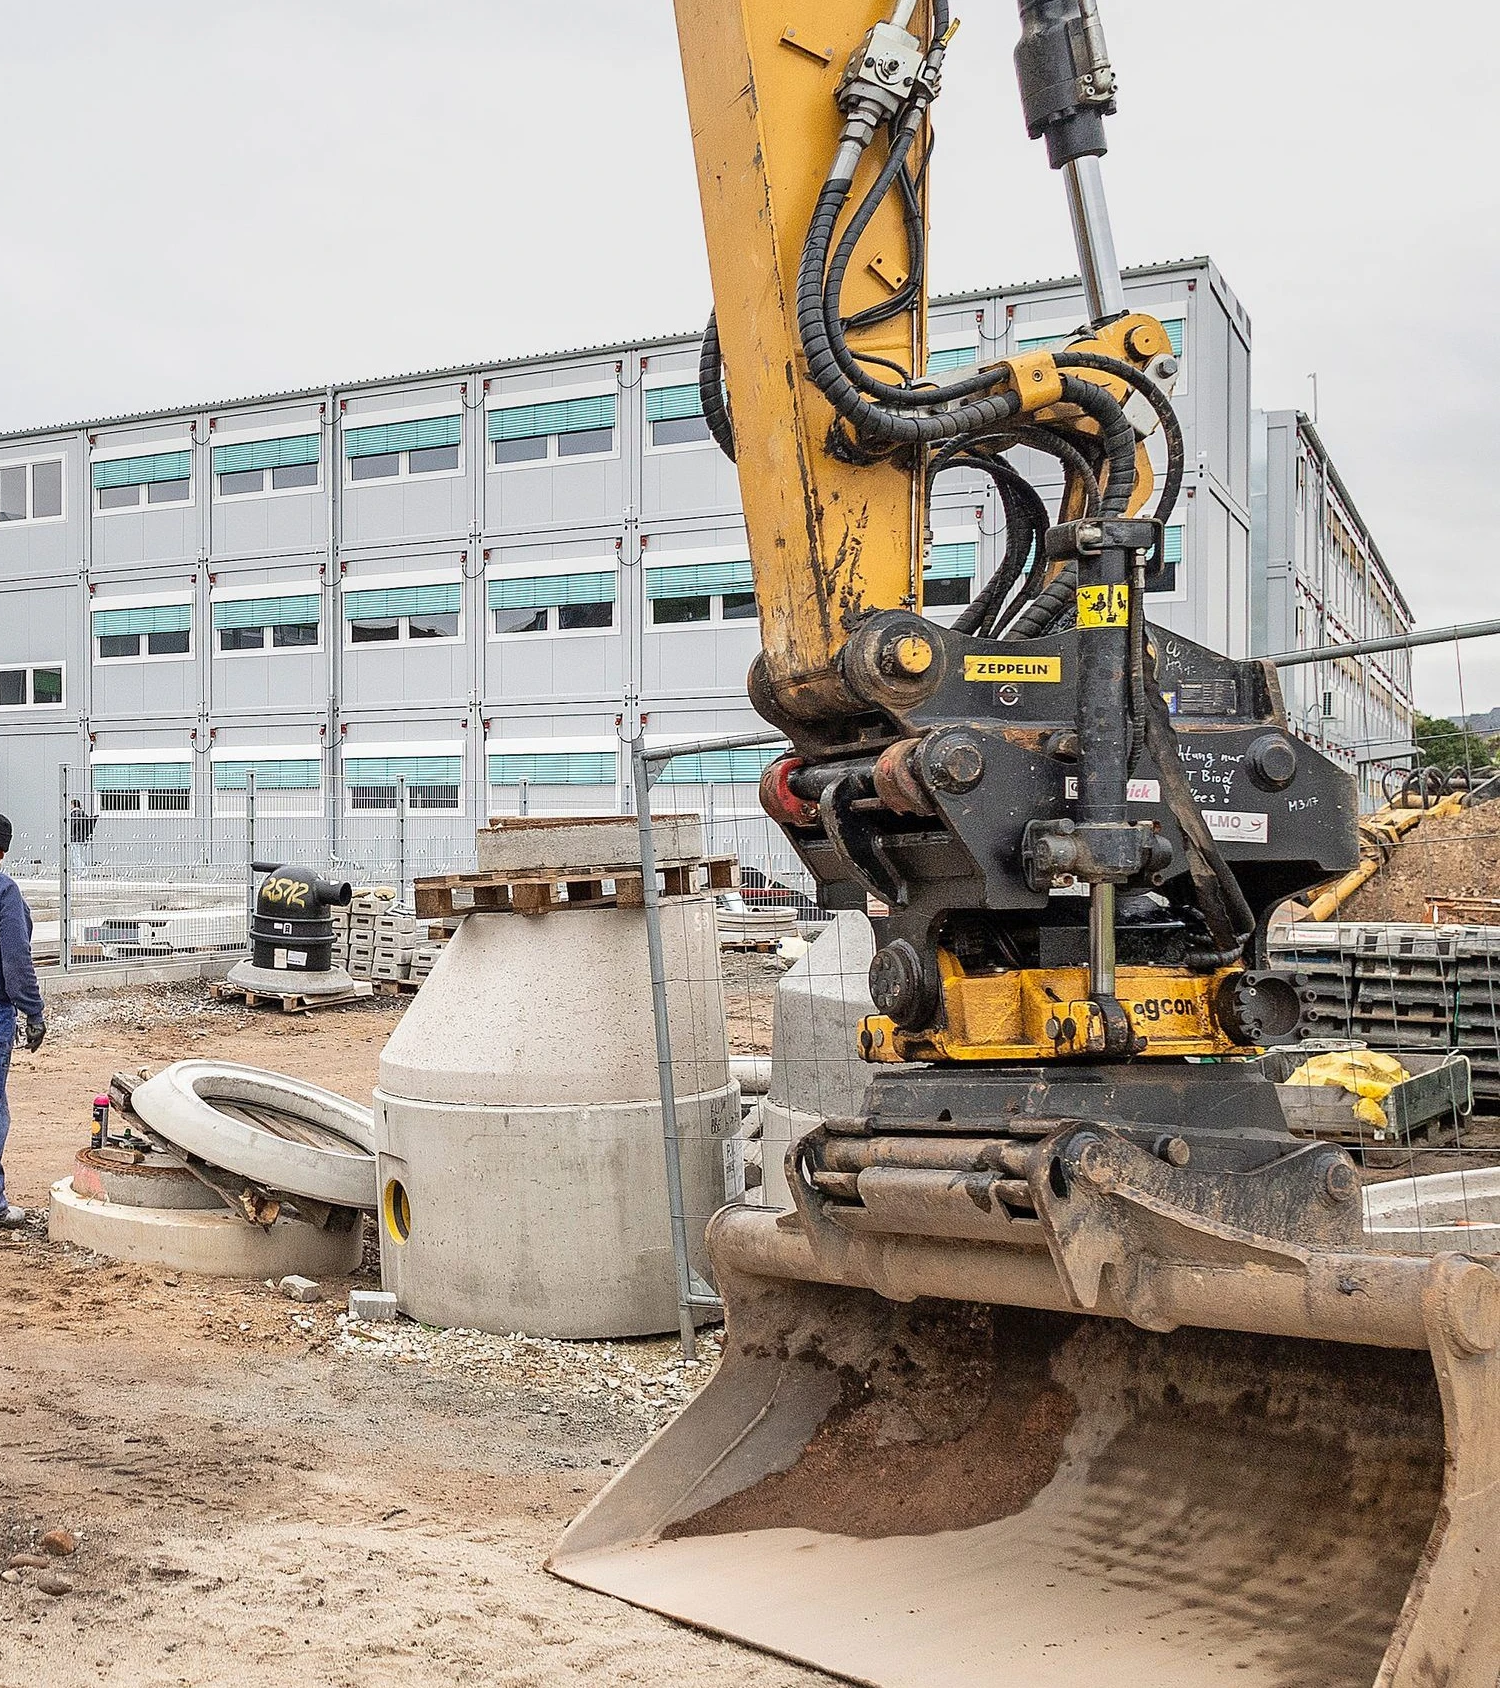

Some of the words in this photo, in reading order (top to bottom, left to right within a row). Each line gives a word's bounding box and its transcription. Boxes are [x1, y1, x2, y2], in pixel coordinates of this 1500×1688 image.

[977, 663, 1049, 675] ZEPPELIN
[1177, 744, 1216, 768] htung
[1220, 754, 1245, 763] nur
